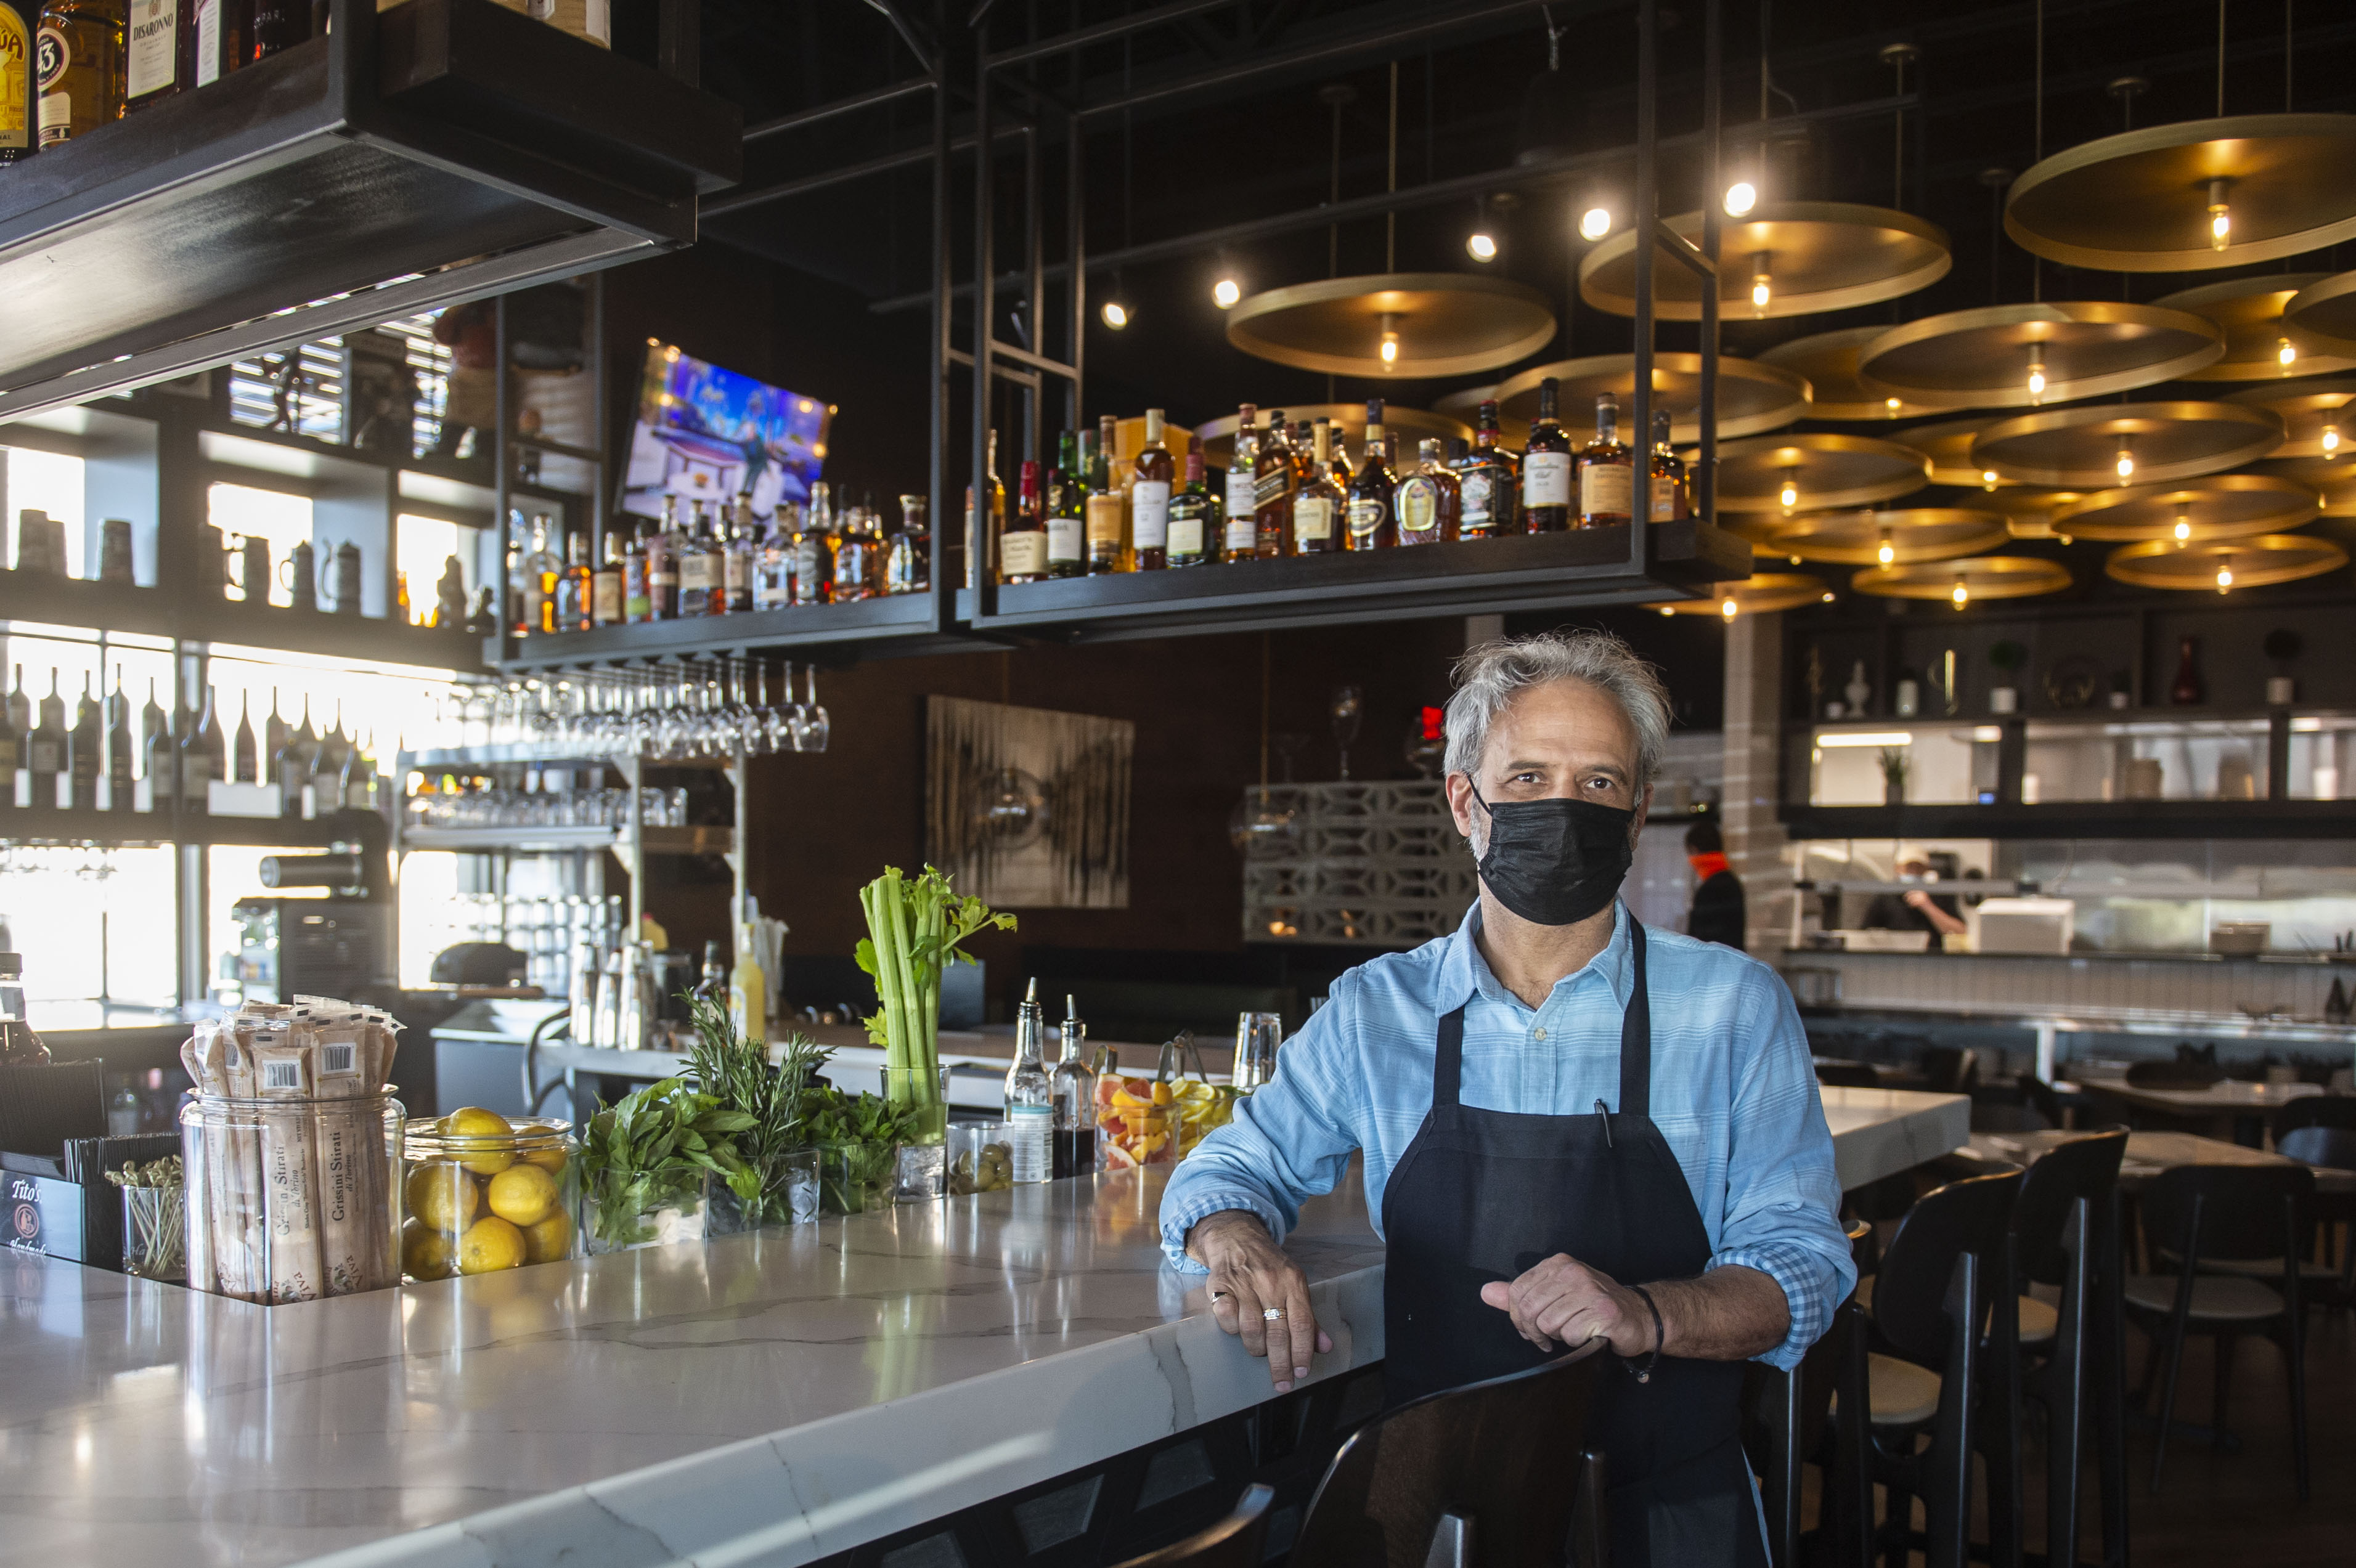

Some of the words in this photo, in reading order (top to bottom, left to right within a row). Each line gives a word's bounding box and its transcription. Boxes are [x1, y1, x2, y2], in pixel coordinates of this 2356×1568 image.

[133, 13, 173, 41] DISARONNO
[38, 43, 55, 73] 43
[274, 1146, 288, 1185] Stirati
[330, 1131, 343, 1171] Stirati
[12, 1179, 41, 1202] Tito's
[332, 1176, 344, 1222] Grissini
[345, 1184, 353, 1192] di
[346, 1254, 363, 1288] Viva
